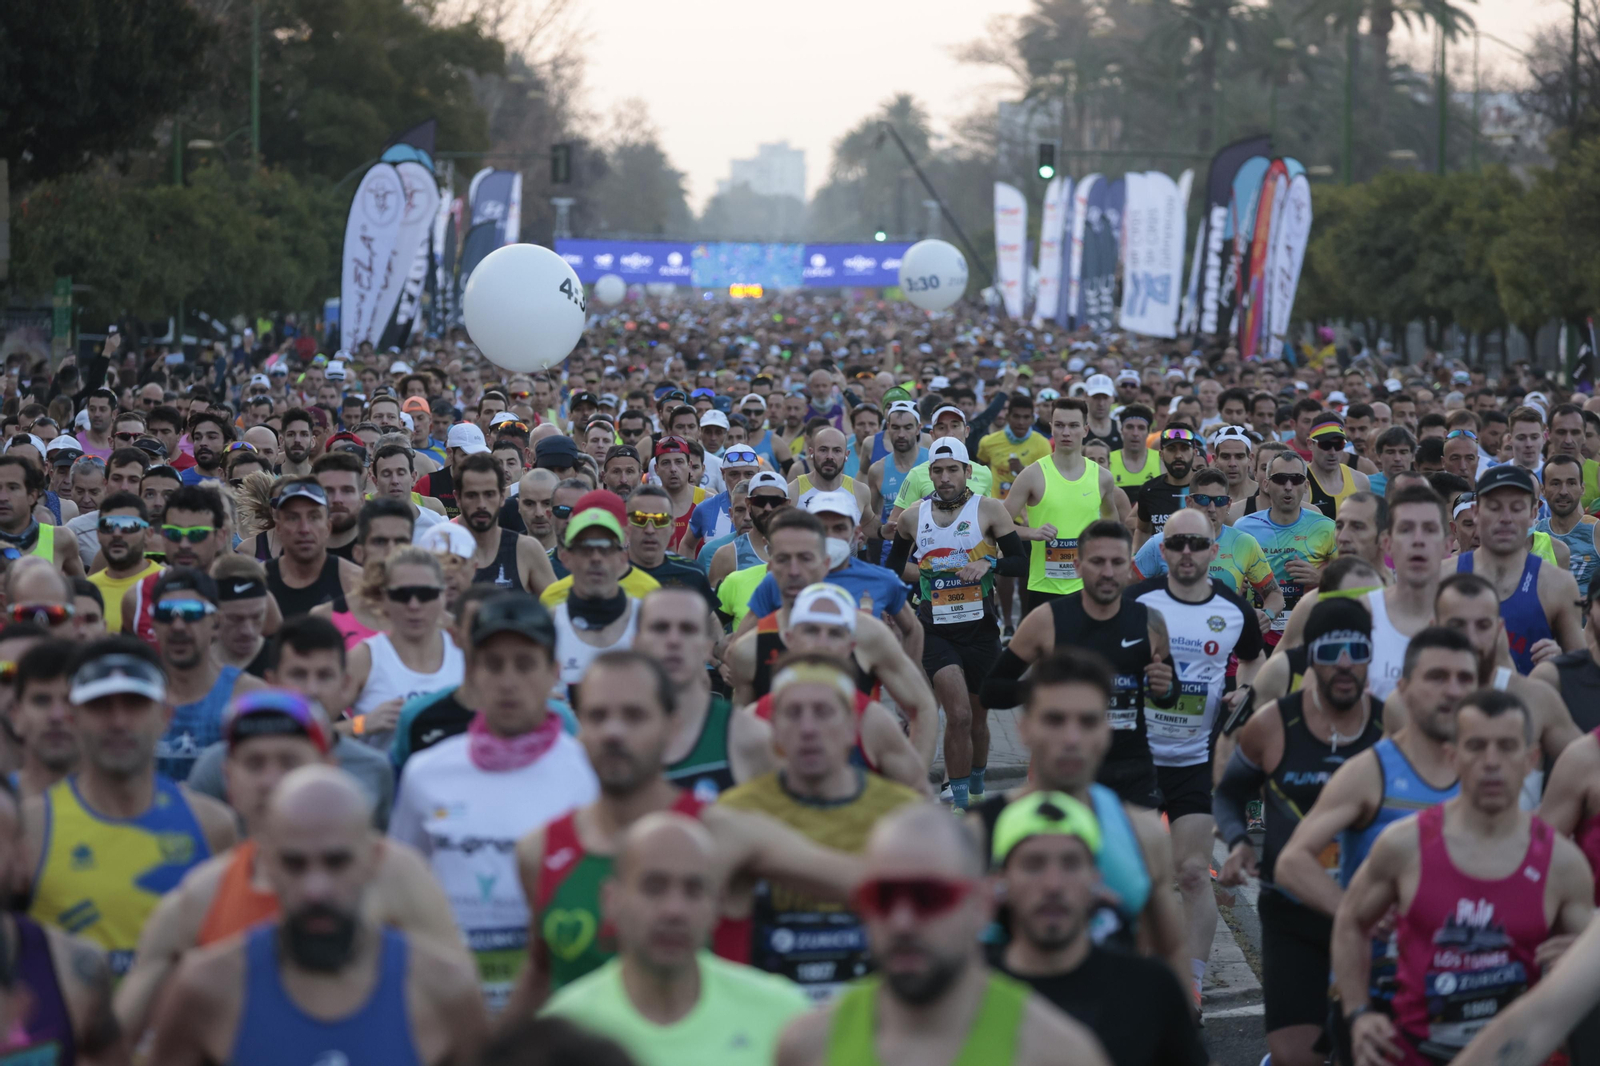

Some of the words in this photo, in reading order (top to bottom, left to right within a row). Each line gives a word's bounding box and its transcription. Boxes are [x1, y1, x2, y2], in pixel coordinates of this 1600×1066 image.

[906, 275, 940, 292] 1:30
[947, 593, 965, 602] 3602
[1154, 712, 1189, 724] KENNETH
